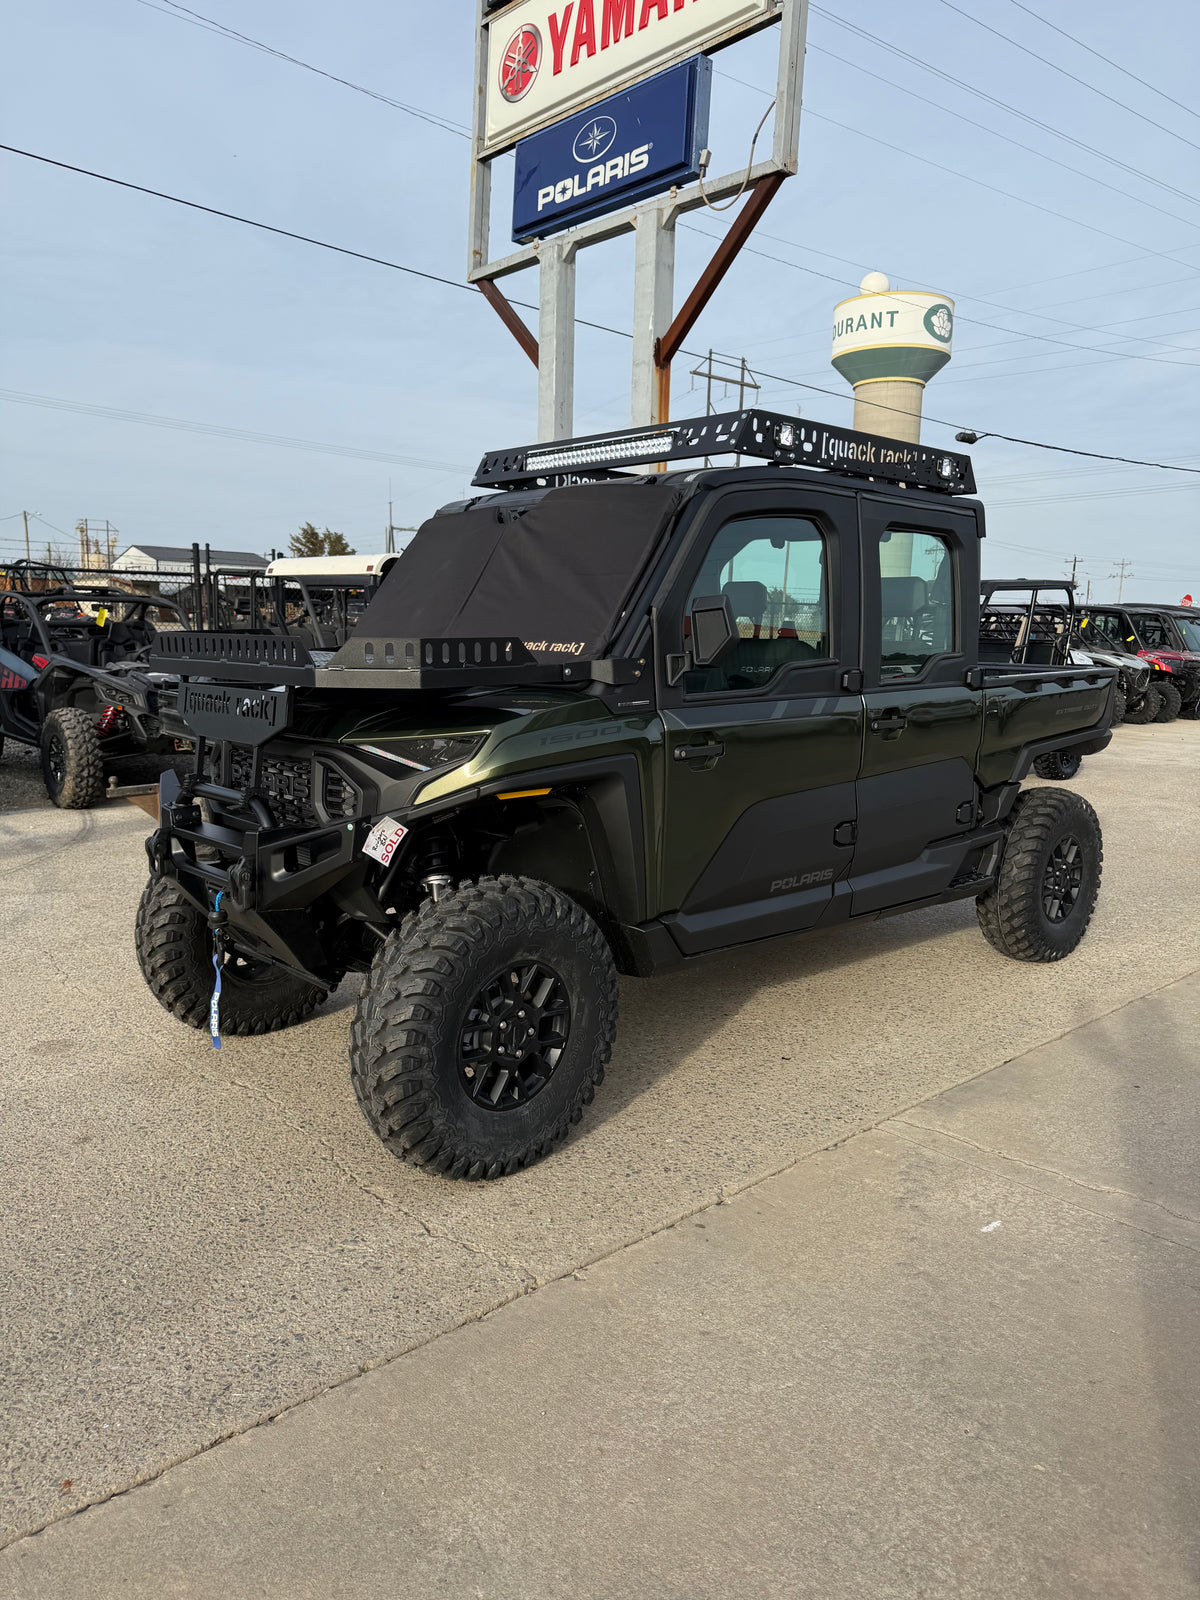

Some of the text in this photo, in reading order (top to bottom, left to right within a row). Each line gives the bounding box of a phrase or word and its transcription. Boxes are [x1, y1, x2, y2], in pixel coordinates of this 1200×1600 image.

[539, 725, 622, 747] 1500
[381, 827, 405, 863] SOLD
[769, 868, 834, 893] POLARIS
[211, 992, 220, 1037] POLARIS
